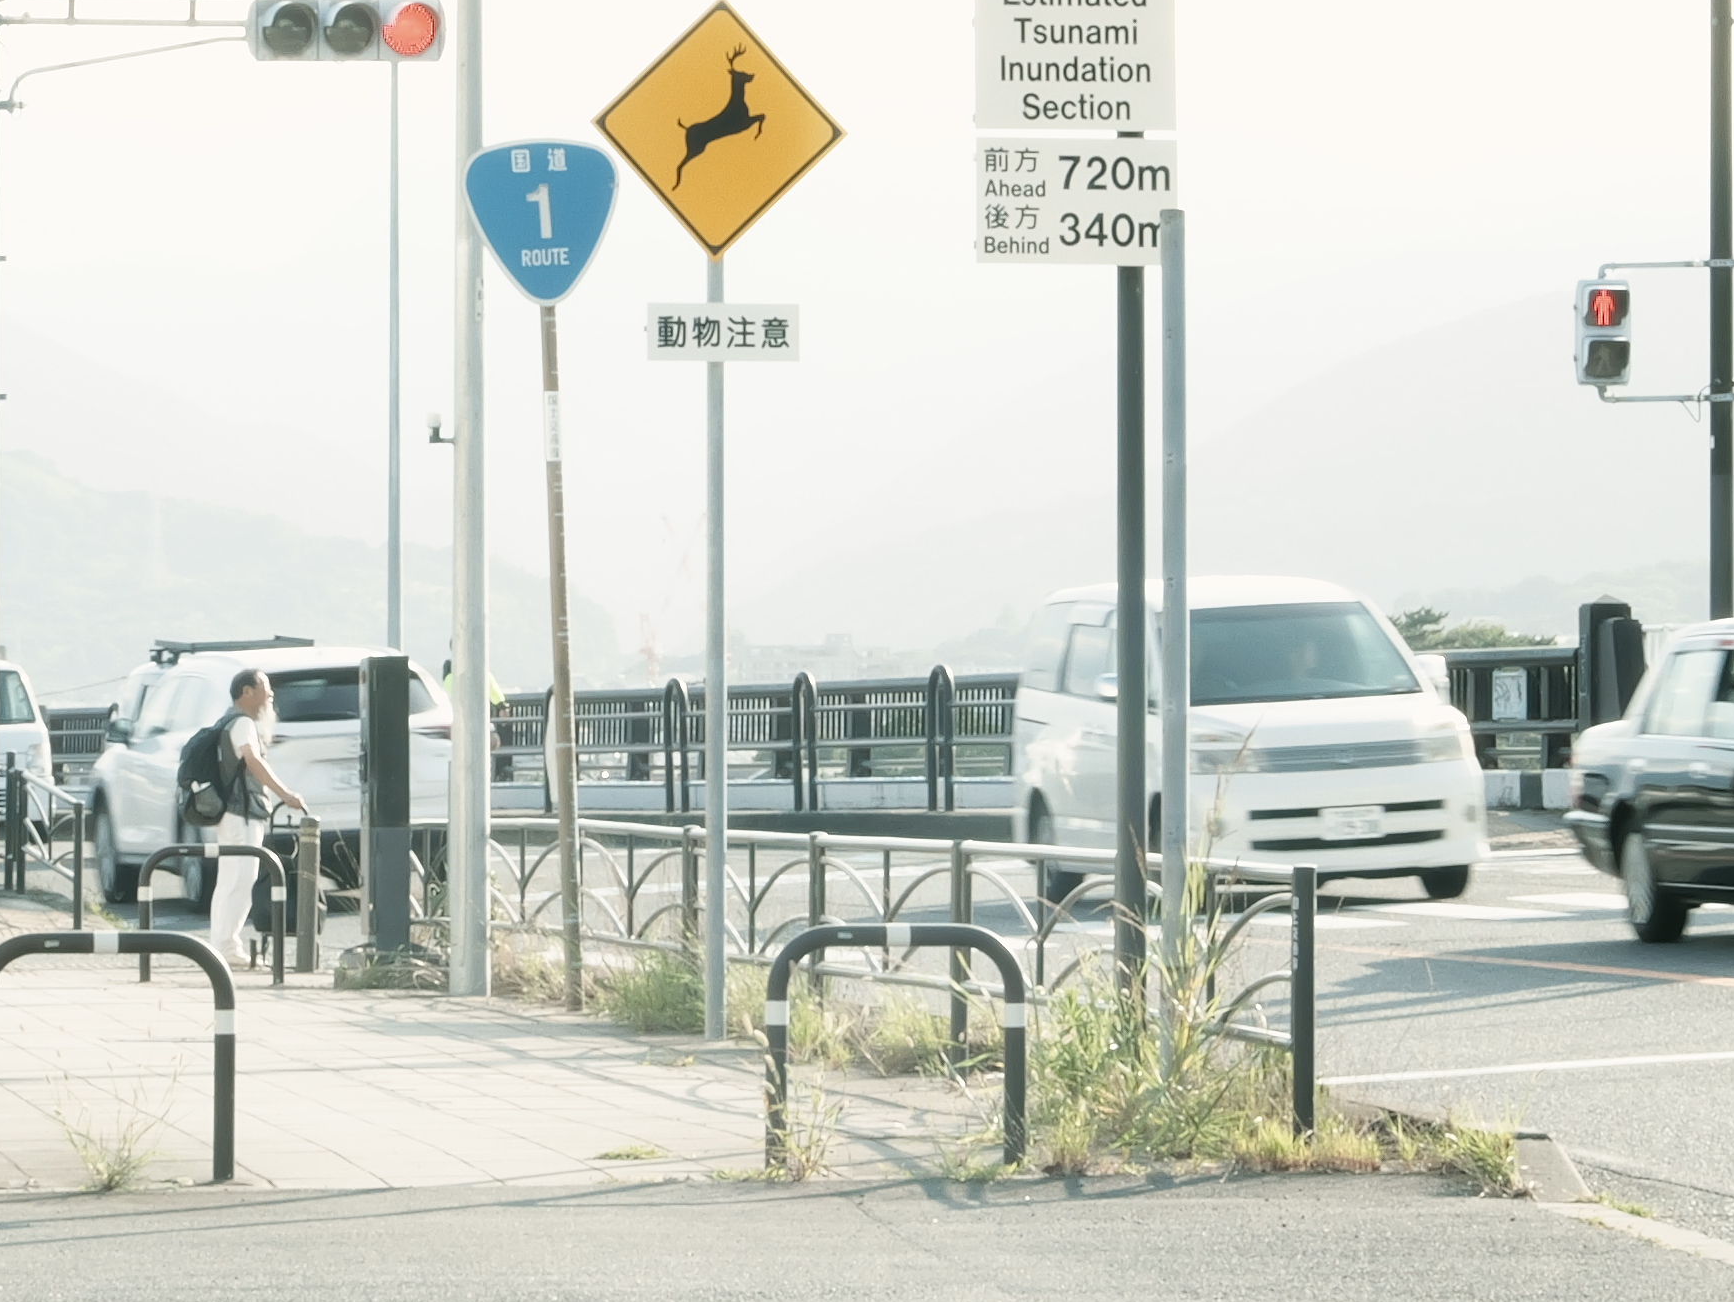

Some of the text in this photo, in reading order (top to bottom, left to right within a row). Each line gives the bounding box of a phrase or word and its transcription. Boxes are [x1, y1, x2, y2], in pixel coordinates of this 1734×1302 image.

[1013, 17, 1139, 45] Tsunami
[1000, 55, 1152, 83] Inundation
[1021, 93, 1132, 121] Section
[510, 148, 568, 173] 国道
[983, 147, 1040, 174] 前方
[1057, 156, 1171, 191] 720m
[984, 179, 1046, 198] Ahead
[525, 183, 553, 240] 1
[983, 203, 1040, 231] 後方
[1057, 212, 1161, 248] 340m
[520, 248, 570, 267] ROUTE
[983, 236, 1050, 255] Behind
[656, 315, 791, 349] 動物注意
